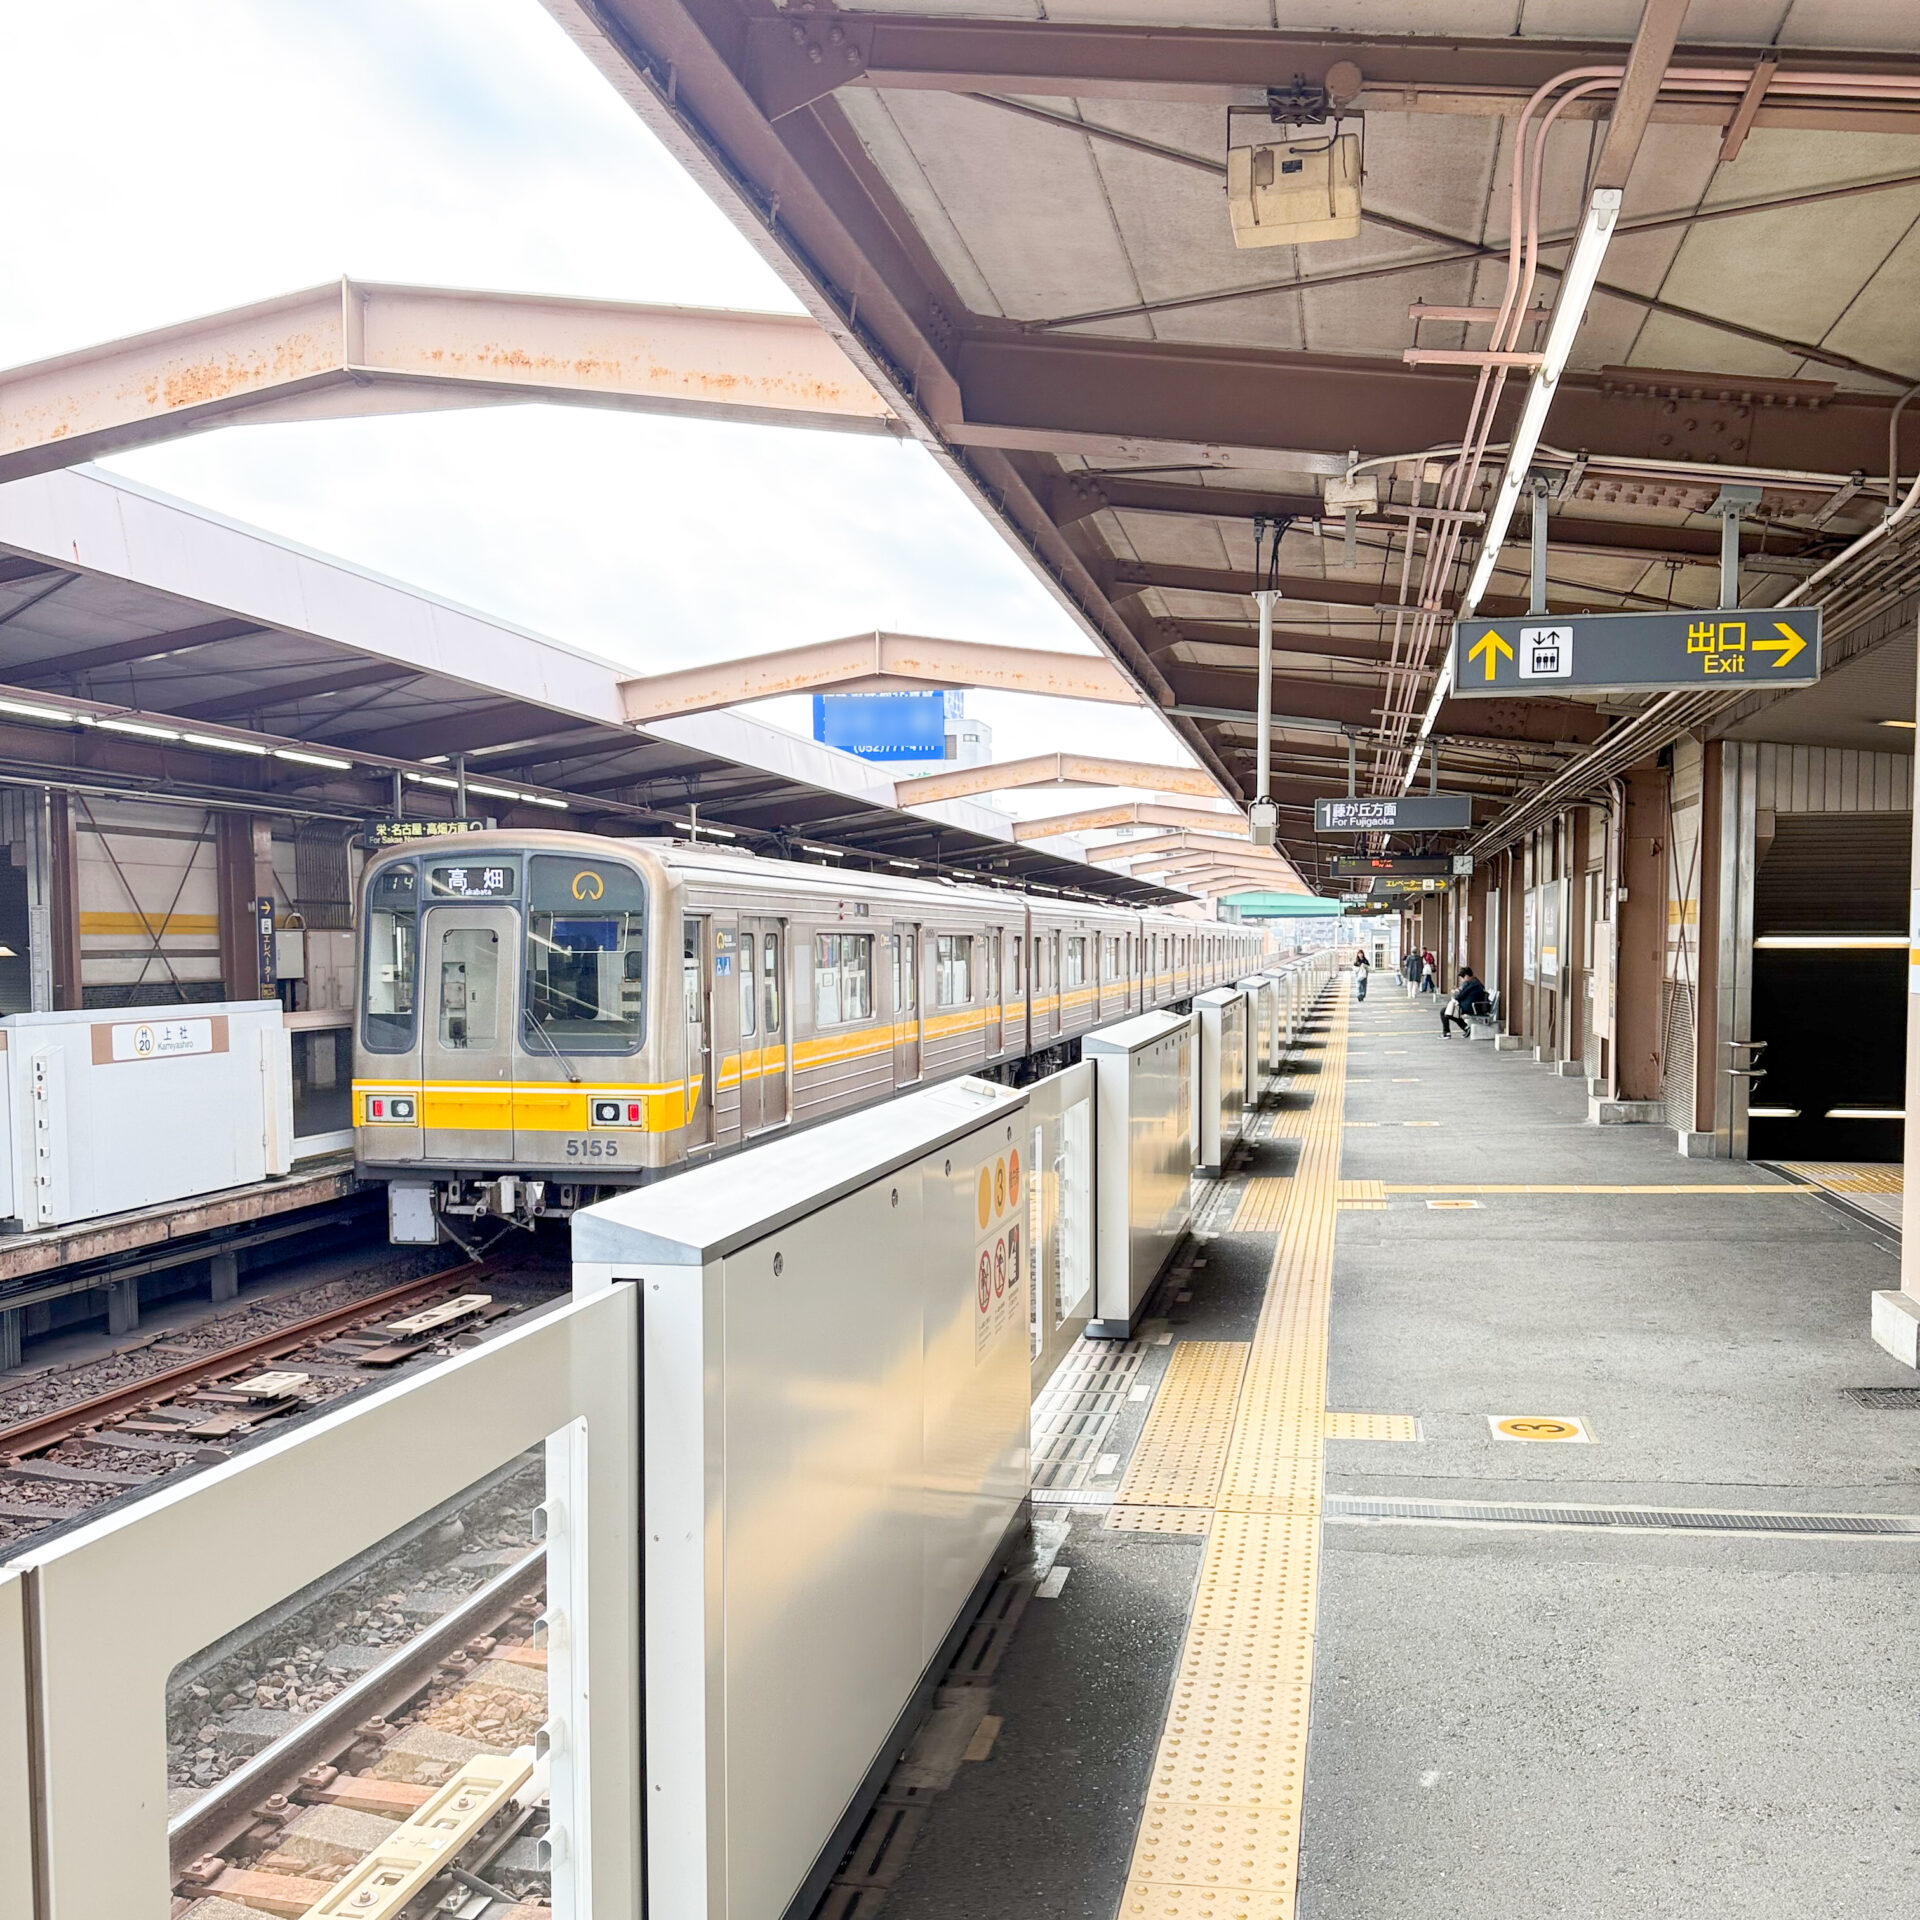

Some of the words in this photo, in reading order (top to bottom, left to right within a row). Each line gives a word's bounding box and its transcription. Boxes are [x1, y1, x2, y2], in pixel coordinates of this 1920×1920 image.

[1687, 621, 1746, 654] 出口
[1703, 654, 1745, 674] Exit
[1321, 803, 1332, 828] 1
[1332, 802, 1397, 817] 藤が丘方面
[1332, 818, 1349, 827] For
[1350, 817, 1395, 828] Fujigaoka
[392, 877, 414, 891] 14
[447, 868, 504, 889] 高畑
[1385, 880, 1422, 888] エレベーター
[460, 888, 493, 896] Takabata
[263, 935, 272, 983] エレベーター
[141, 1029, 148, 1039] H
[163, 1026, 188, 1040] 上社
[139, 1039, 151, 1051] 20
[566, 1139, 618, 1157] 5155
[996, 1168, 1004, 1208] 3
[1511, 1423, 1565, 1433] 3
